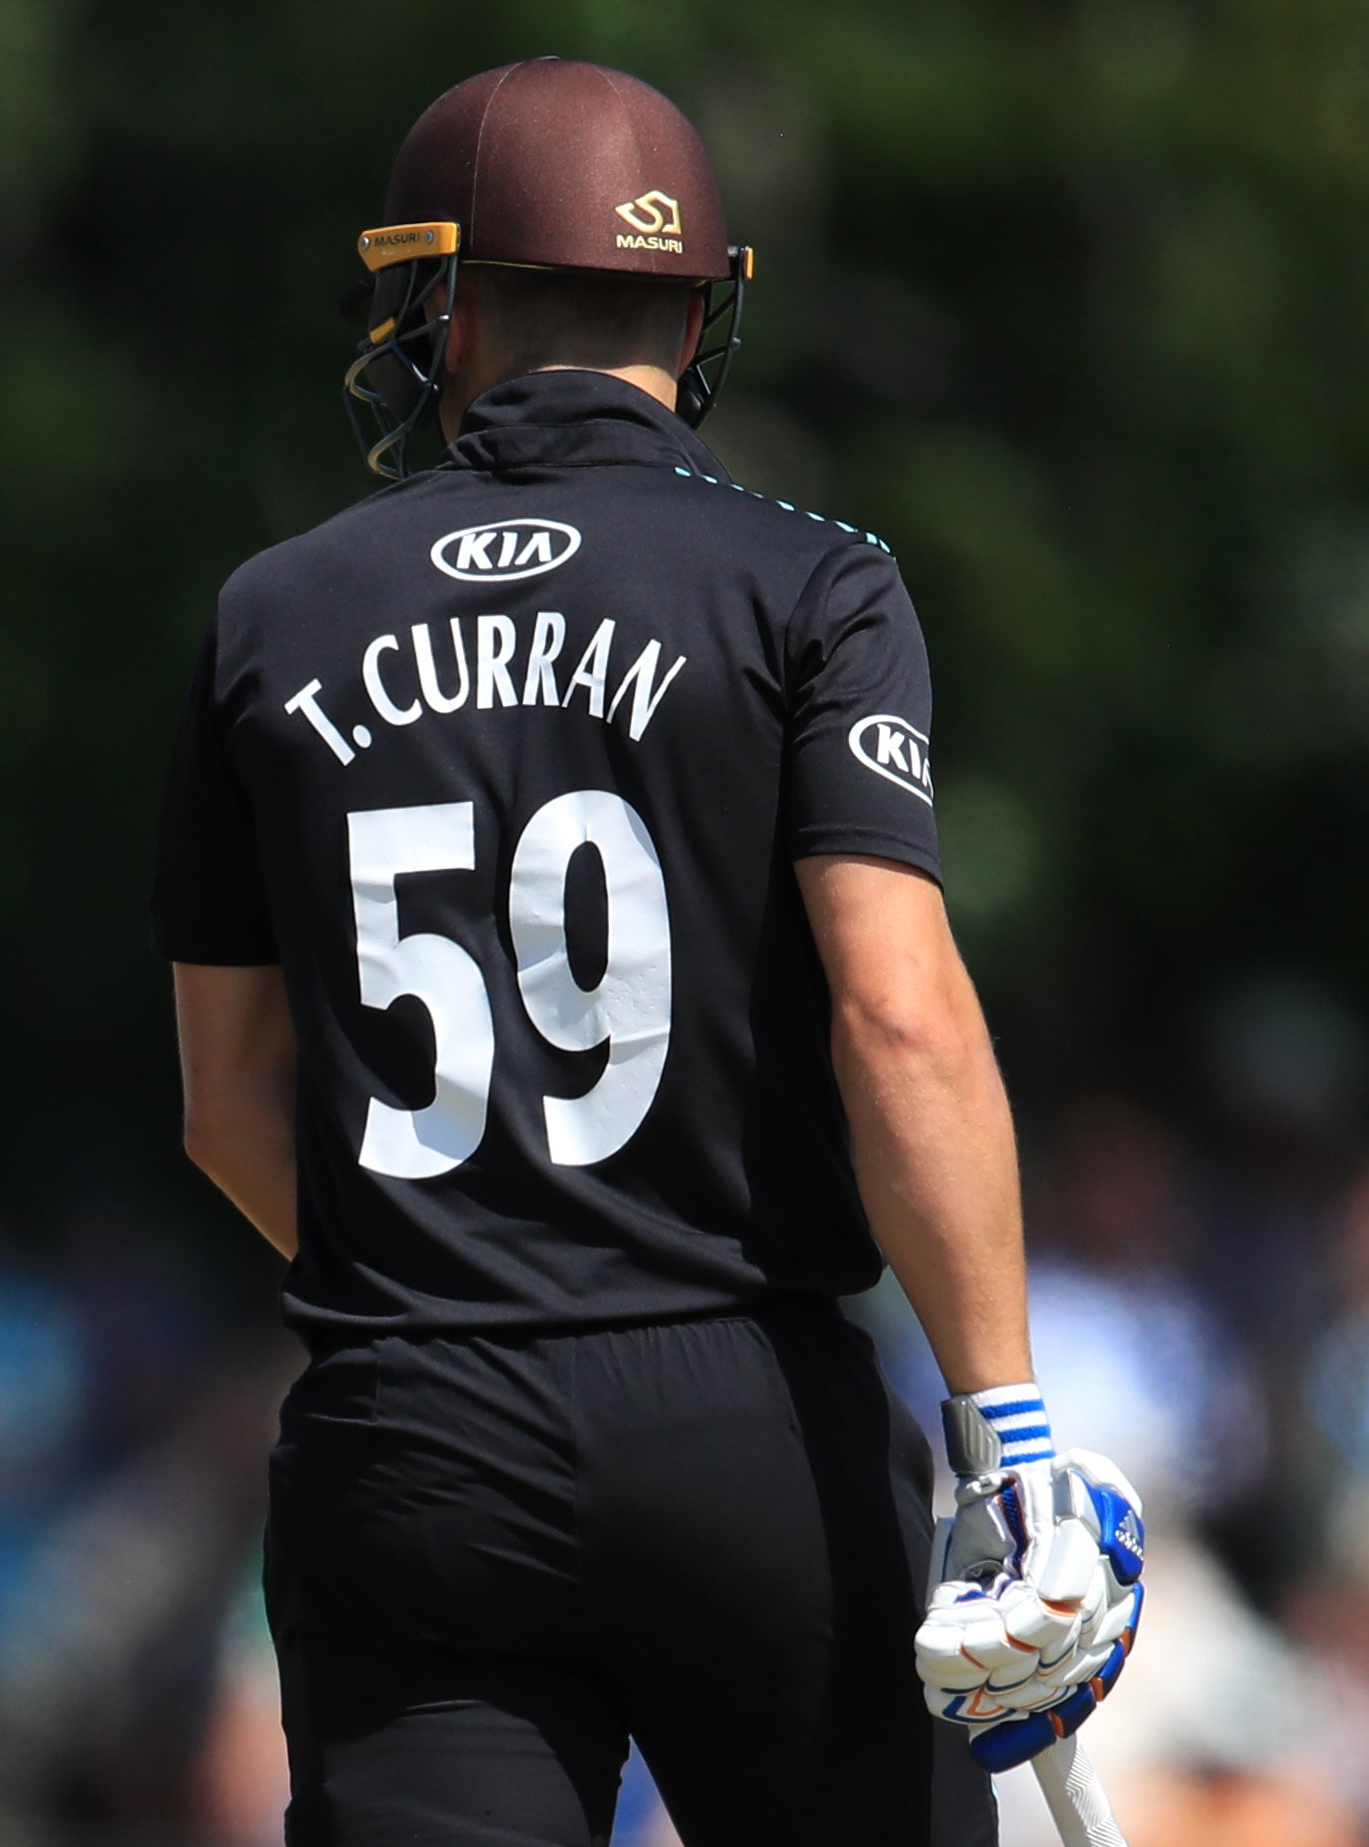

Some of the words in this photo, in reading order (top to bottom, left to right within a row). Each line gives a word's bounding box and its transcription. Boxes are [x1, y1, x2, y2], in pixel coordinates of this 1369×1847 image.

[374, 232, 420, 247] MASURI
[616, 234, 683, 254] MASURI
[456, 531, 552, 570] KIA
[284, 611, 687, 766] T.CURRAN
[346, 789, 673, 1180] 59
